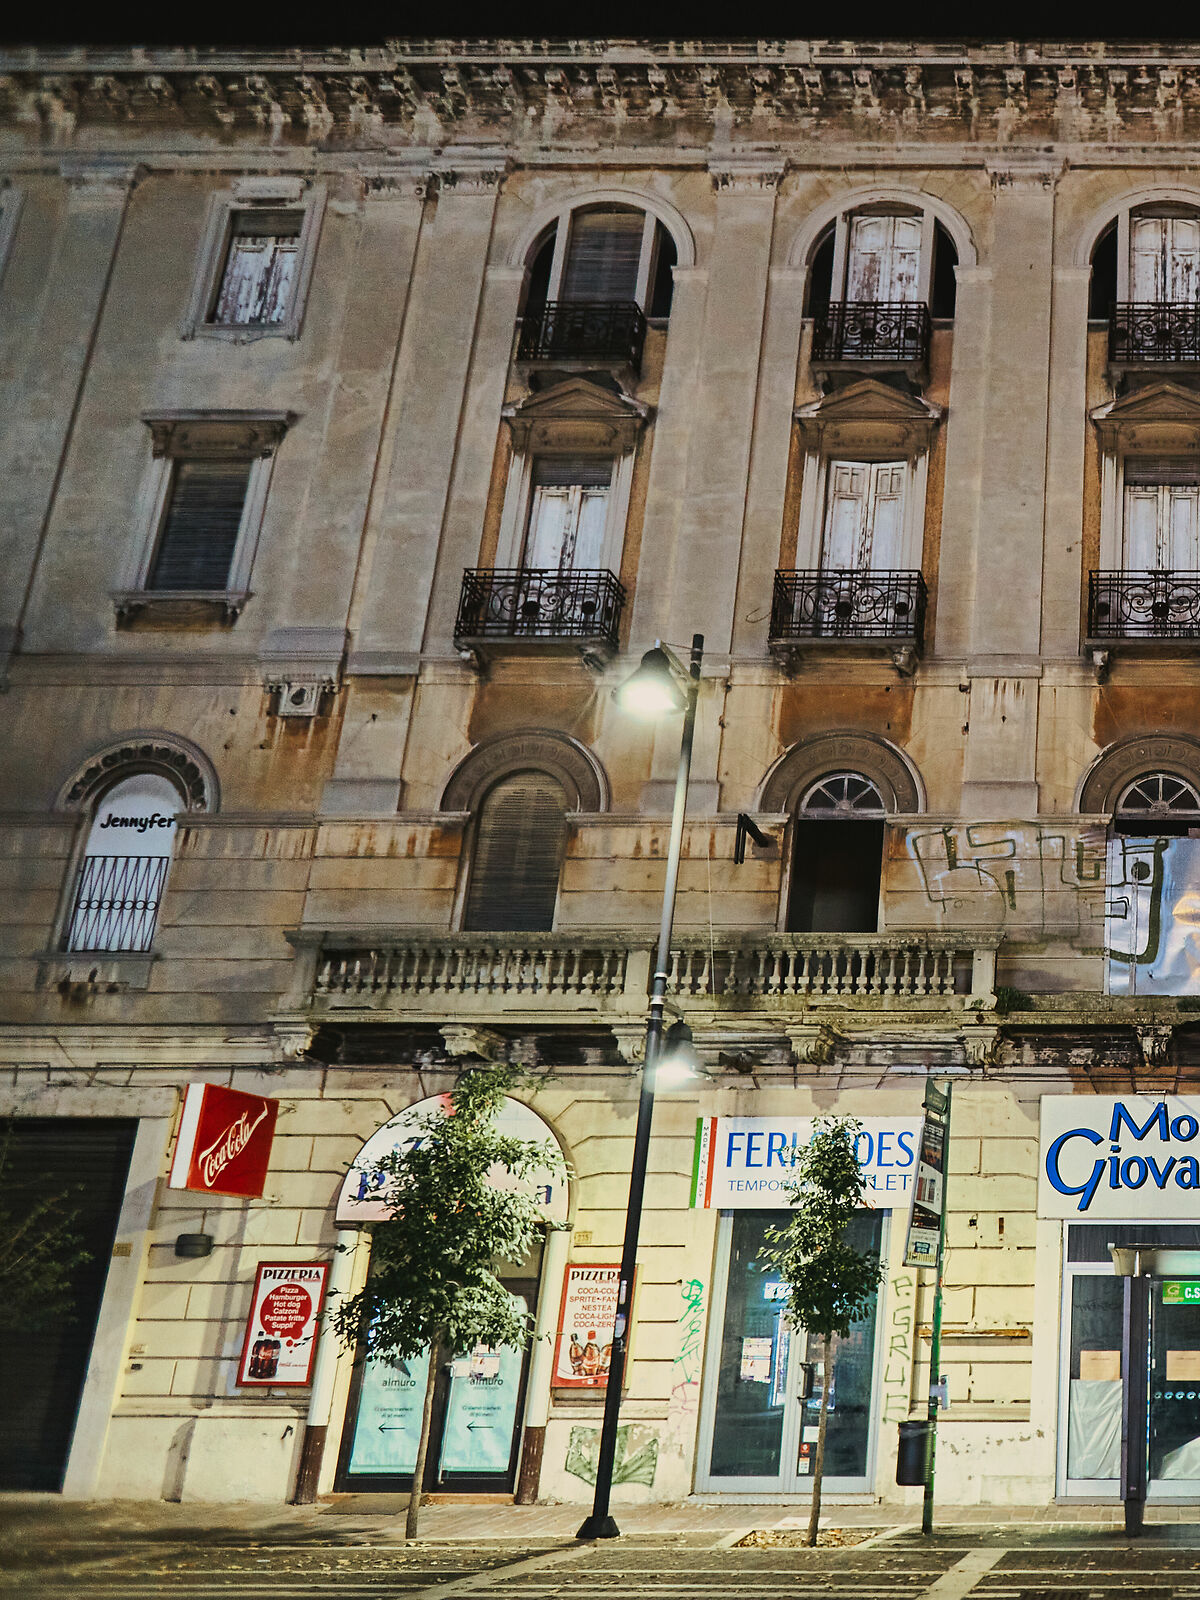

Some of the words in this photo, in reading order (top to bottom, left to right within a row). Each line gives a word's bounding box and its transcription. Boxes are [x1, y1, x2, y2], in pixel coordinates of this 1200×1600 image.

[100, 813, 176, 833] Jennyfer
[810, 1131, 914, 1168] OES
[263, 1269, 320, 1280] PIZZERIA
[571, 1271, 621, 1281] PIZZERI
[269, 1294, 308, 1302] Hamburger
[287, 1301, 301, 1309] dog
[382, 1378, 417, 1387] almuro
[469, 1377, 504, 1386] almuro
